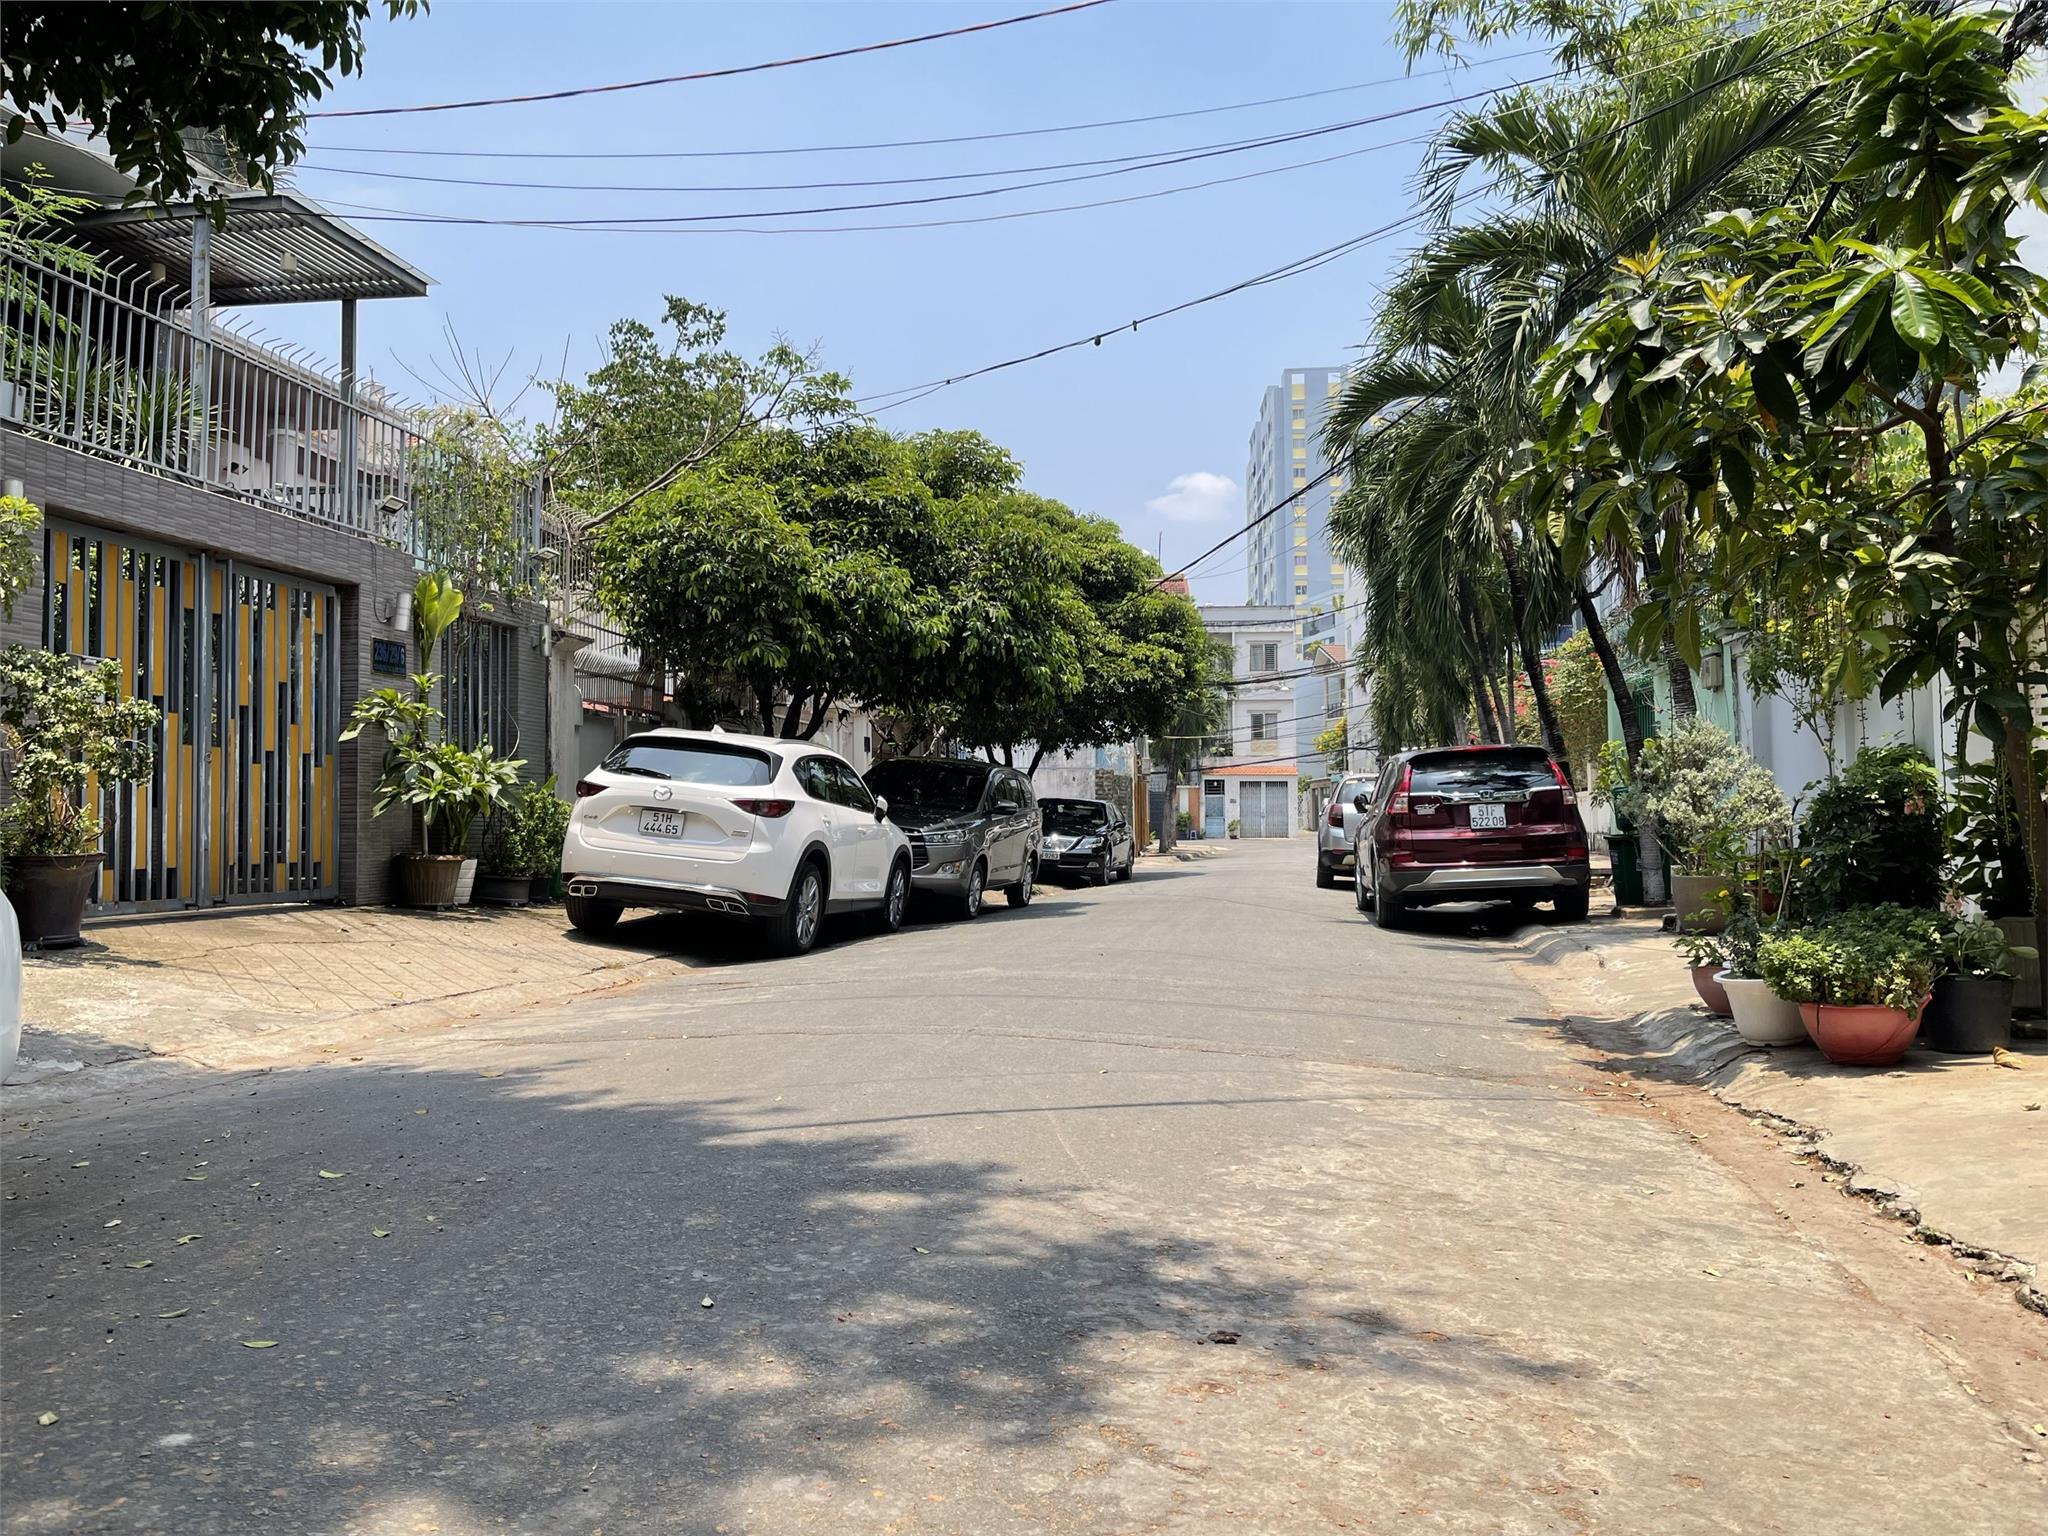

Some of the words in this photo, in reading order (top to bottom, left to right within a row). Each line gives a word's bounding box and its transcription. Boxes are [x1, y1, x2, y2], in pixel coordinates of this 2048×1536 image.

[1478, 806, 1496, 816] 51F
[652, 812, 673, 823] 51H
[643, 821, 679, 835] 444.65
